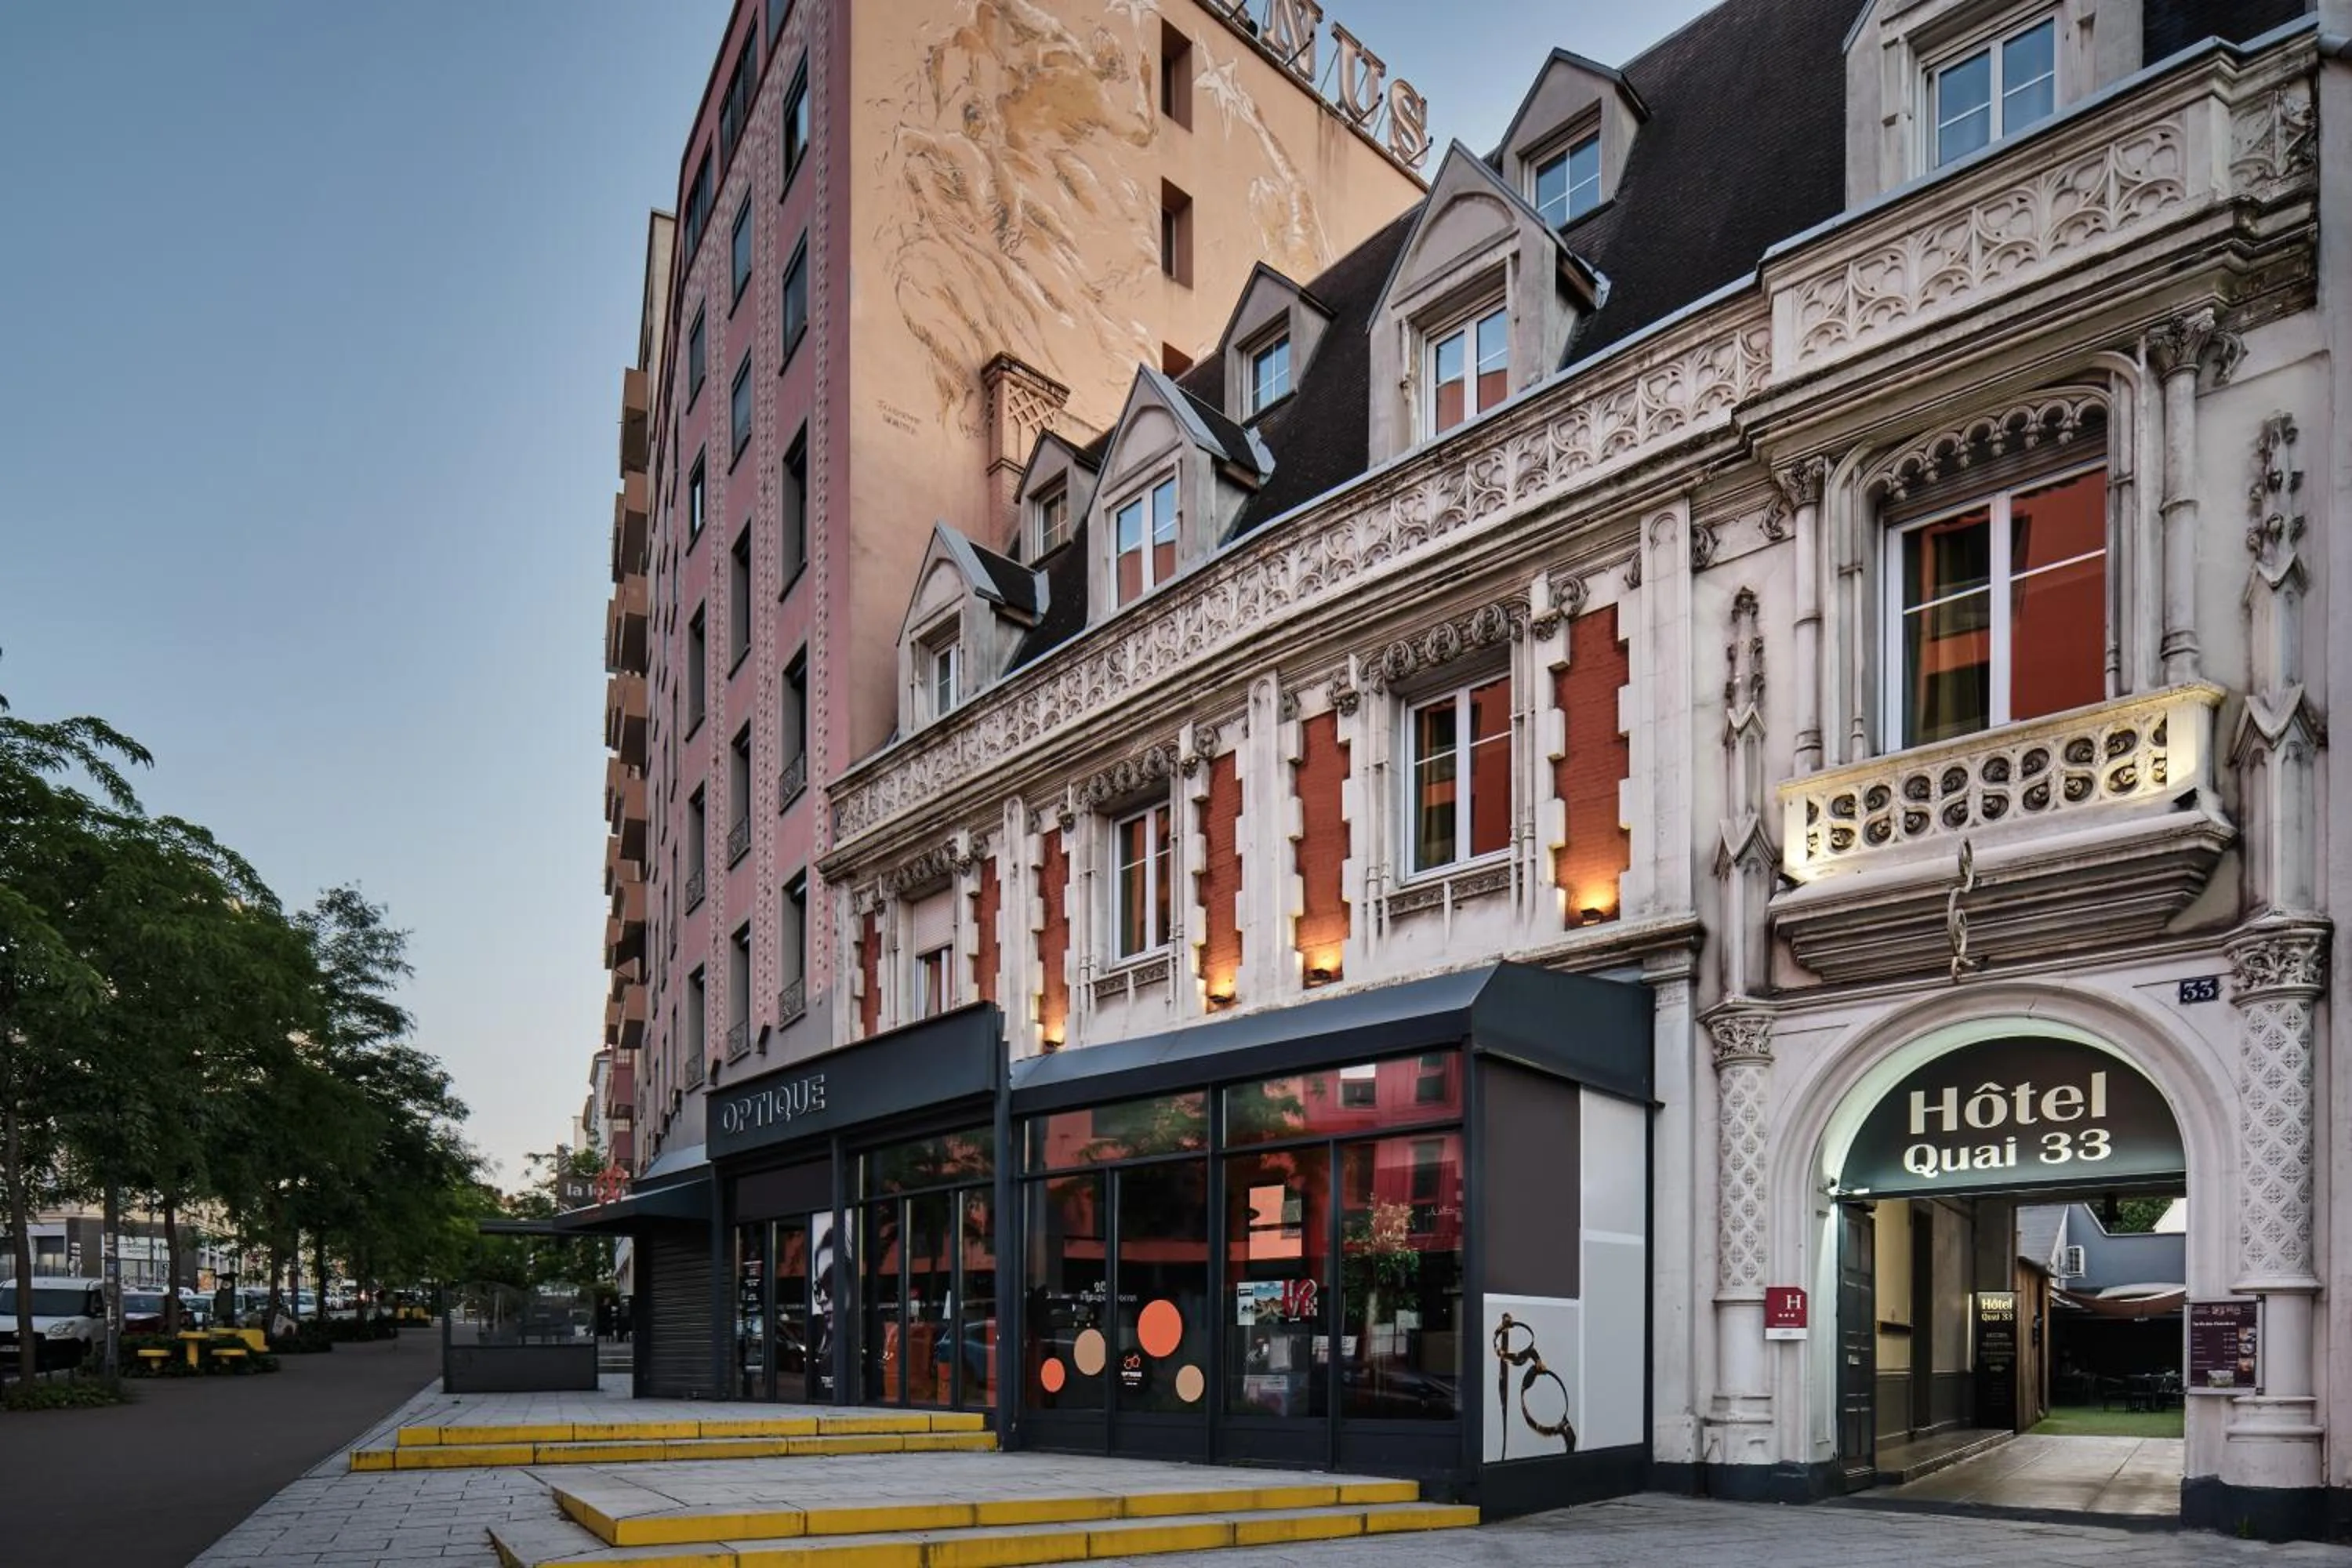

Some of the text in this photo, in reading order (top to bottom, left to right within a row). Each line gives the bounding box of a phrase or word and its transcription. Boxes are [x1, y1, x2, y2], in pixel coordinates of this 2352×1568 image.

[1212, 0, 1428, 169] NUS
[2183, 980, 2215, 1000] 33
[723, 1073, 826, 1134] OPTIQUE
[1908, 1070, 2107, 1135] Hôtel
[1903, 1128, 2112, 1178] Quai 33
[1786, 1294, 1802, 1309] H
[1981, 1298, 2013, 1310] Hôtel
